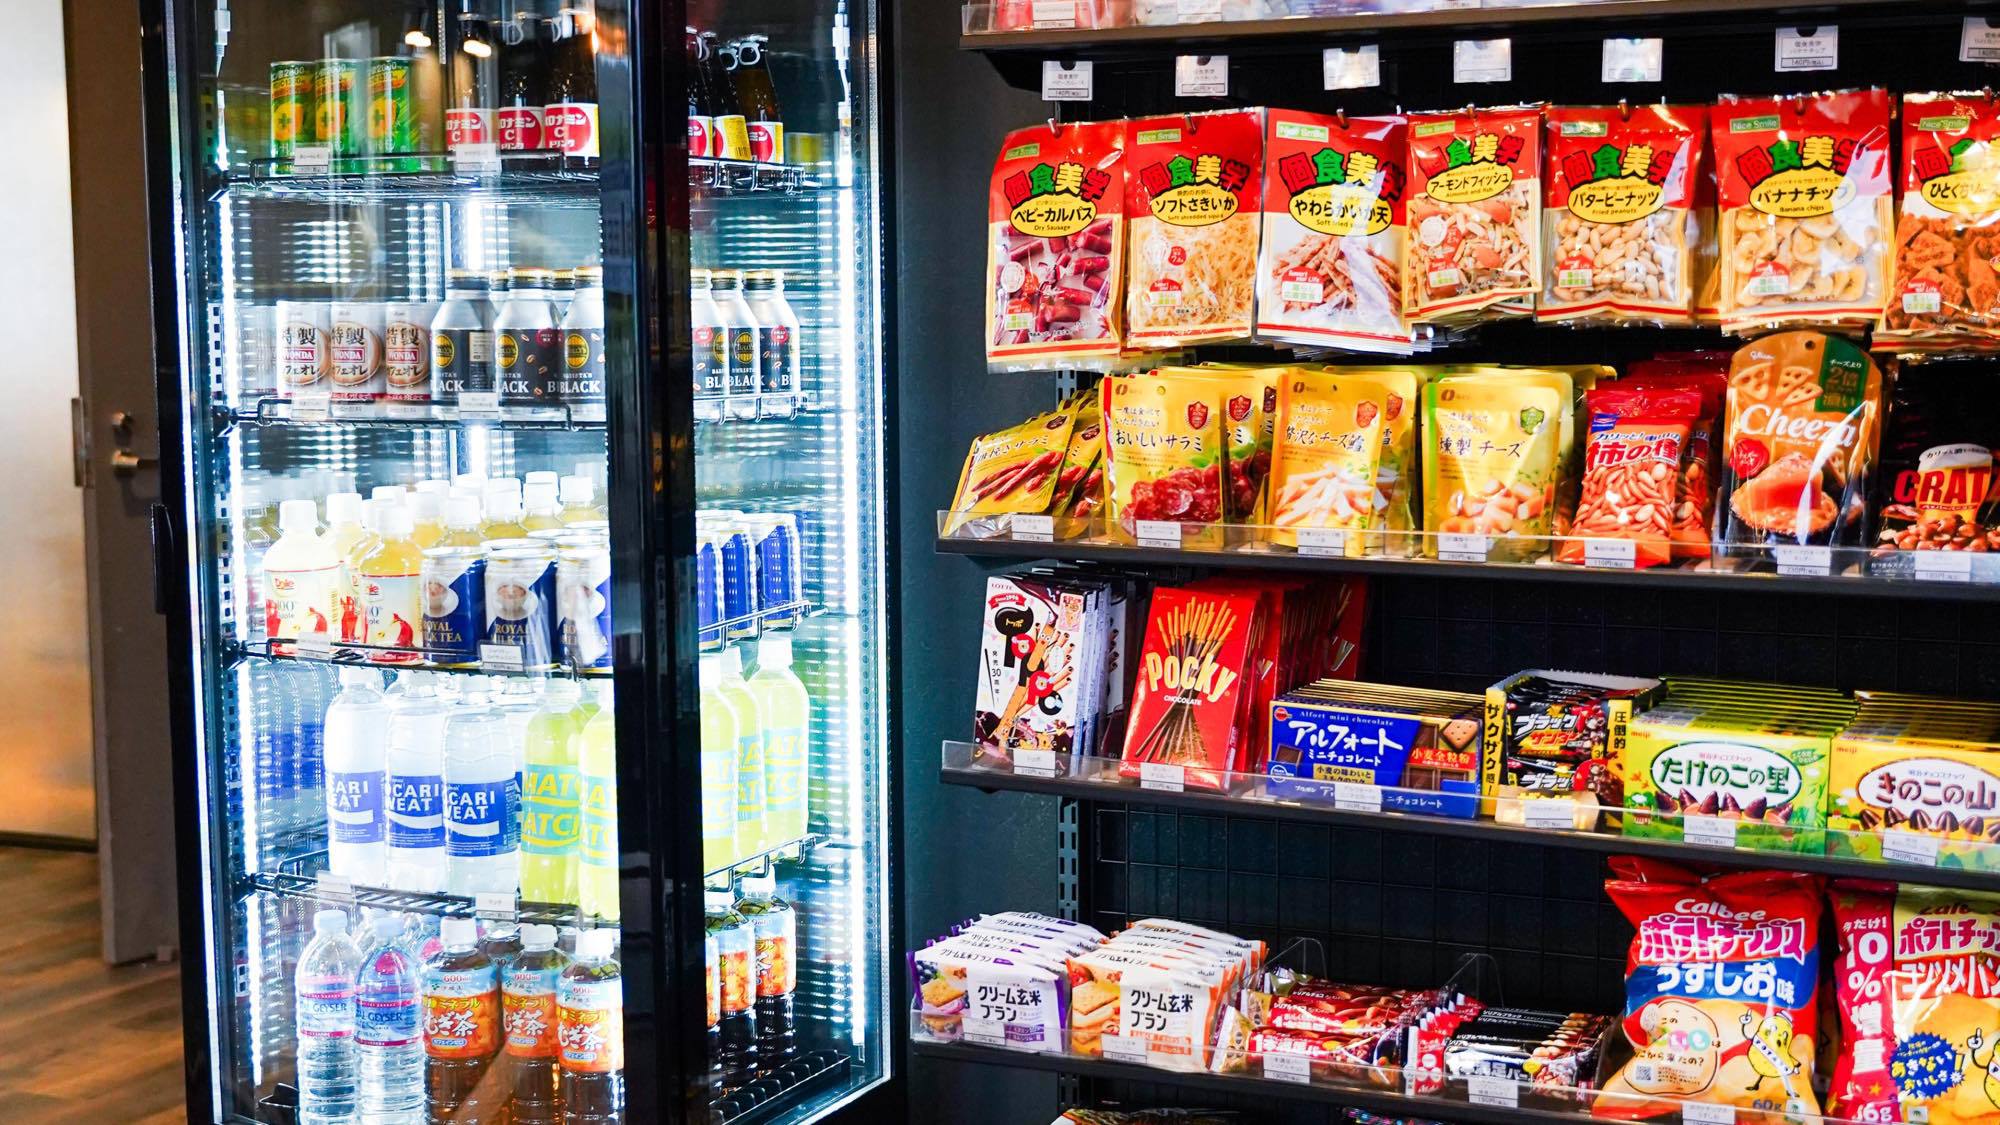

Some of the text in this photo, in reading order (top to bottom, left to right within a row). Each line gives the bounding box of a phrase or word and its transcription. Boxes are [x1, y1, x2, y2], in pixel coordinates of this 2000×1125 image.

[1754, 120, 1777, 128] Smile
[451, 132, 461, 142] C
[504, 130, 516, 140] C
[554, 127, 565, 138] C
[1140, 154, 1251, 199] 個食美学
[1431, 172, 1510, 193] アーモンドフィッシュ
[1155, 196, 1235, 213] ソフトさきいか
[1573, 191, 1660, 208] バターピーナッツ
[1014, 207, 1093, 223] ベビーカルパス
[1806, 205, 1825, 213] chips
[388, 351, 417, 360] WONDA
[1830, 359, 1862, 368] チーズより
[559, 380, 601, 393] BLACK
[1740, 403, 1856, 448] Cheeza
[1115, 430, 1202, 451] おいしいサラミ
[1586, 439, 1679, 473] 柿の種
[440, 632, 463, 642] TEA
[1164, 695, 1202, 706] CHOCOLATE
[1300, 711, 1395, 727] Alfort mini chocolate
[1514, 713, 1579, 740] ブラック
[1288, 720, 1404, 756] アルフォート
[1613, 711, 1627, 750] 圧倒的
[1631, 730, 1651, 739] meiji
[1308, 748, 1382, 767] ミニチョコレート
[1412, 748, 1471, 764] 小麦全粒粉
[1836, 746, 1858, 755] meiji
[1316, 766, 1372, 778] 小麦の味わいと
[1660, 756, 1790, 795] たけのこの里
[1876, 771, 1997, 811] きのこの山
[1674, 898, 1767, 921] Calbee
[1639, 912, 1806, 966] ポテトチップス
[1655, 961, 1796, 1005] うすしお味
[440, 998, 481, 1009] ミネラル
[977, 985, 1042, 1007] クリーム玄米
[1131, 989, 1194, 1014] クリーム玄米
[313, 1002, 347, 1013] GEYSER
[980, 1003, 1018, 1022] ブラン
[368, 1012, 403, 1022] GEYSER
[1130, 1010, 1167, 1031] ブラン
[1661, 1017, 1679, 1025] この
